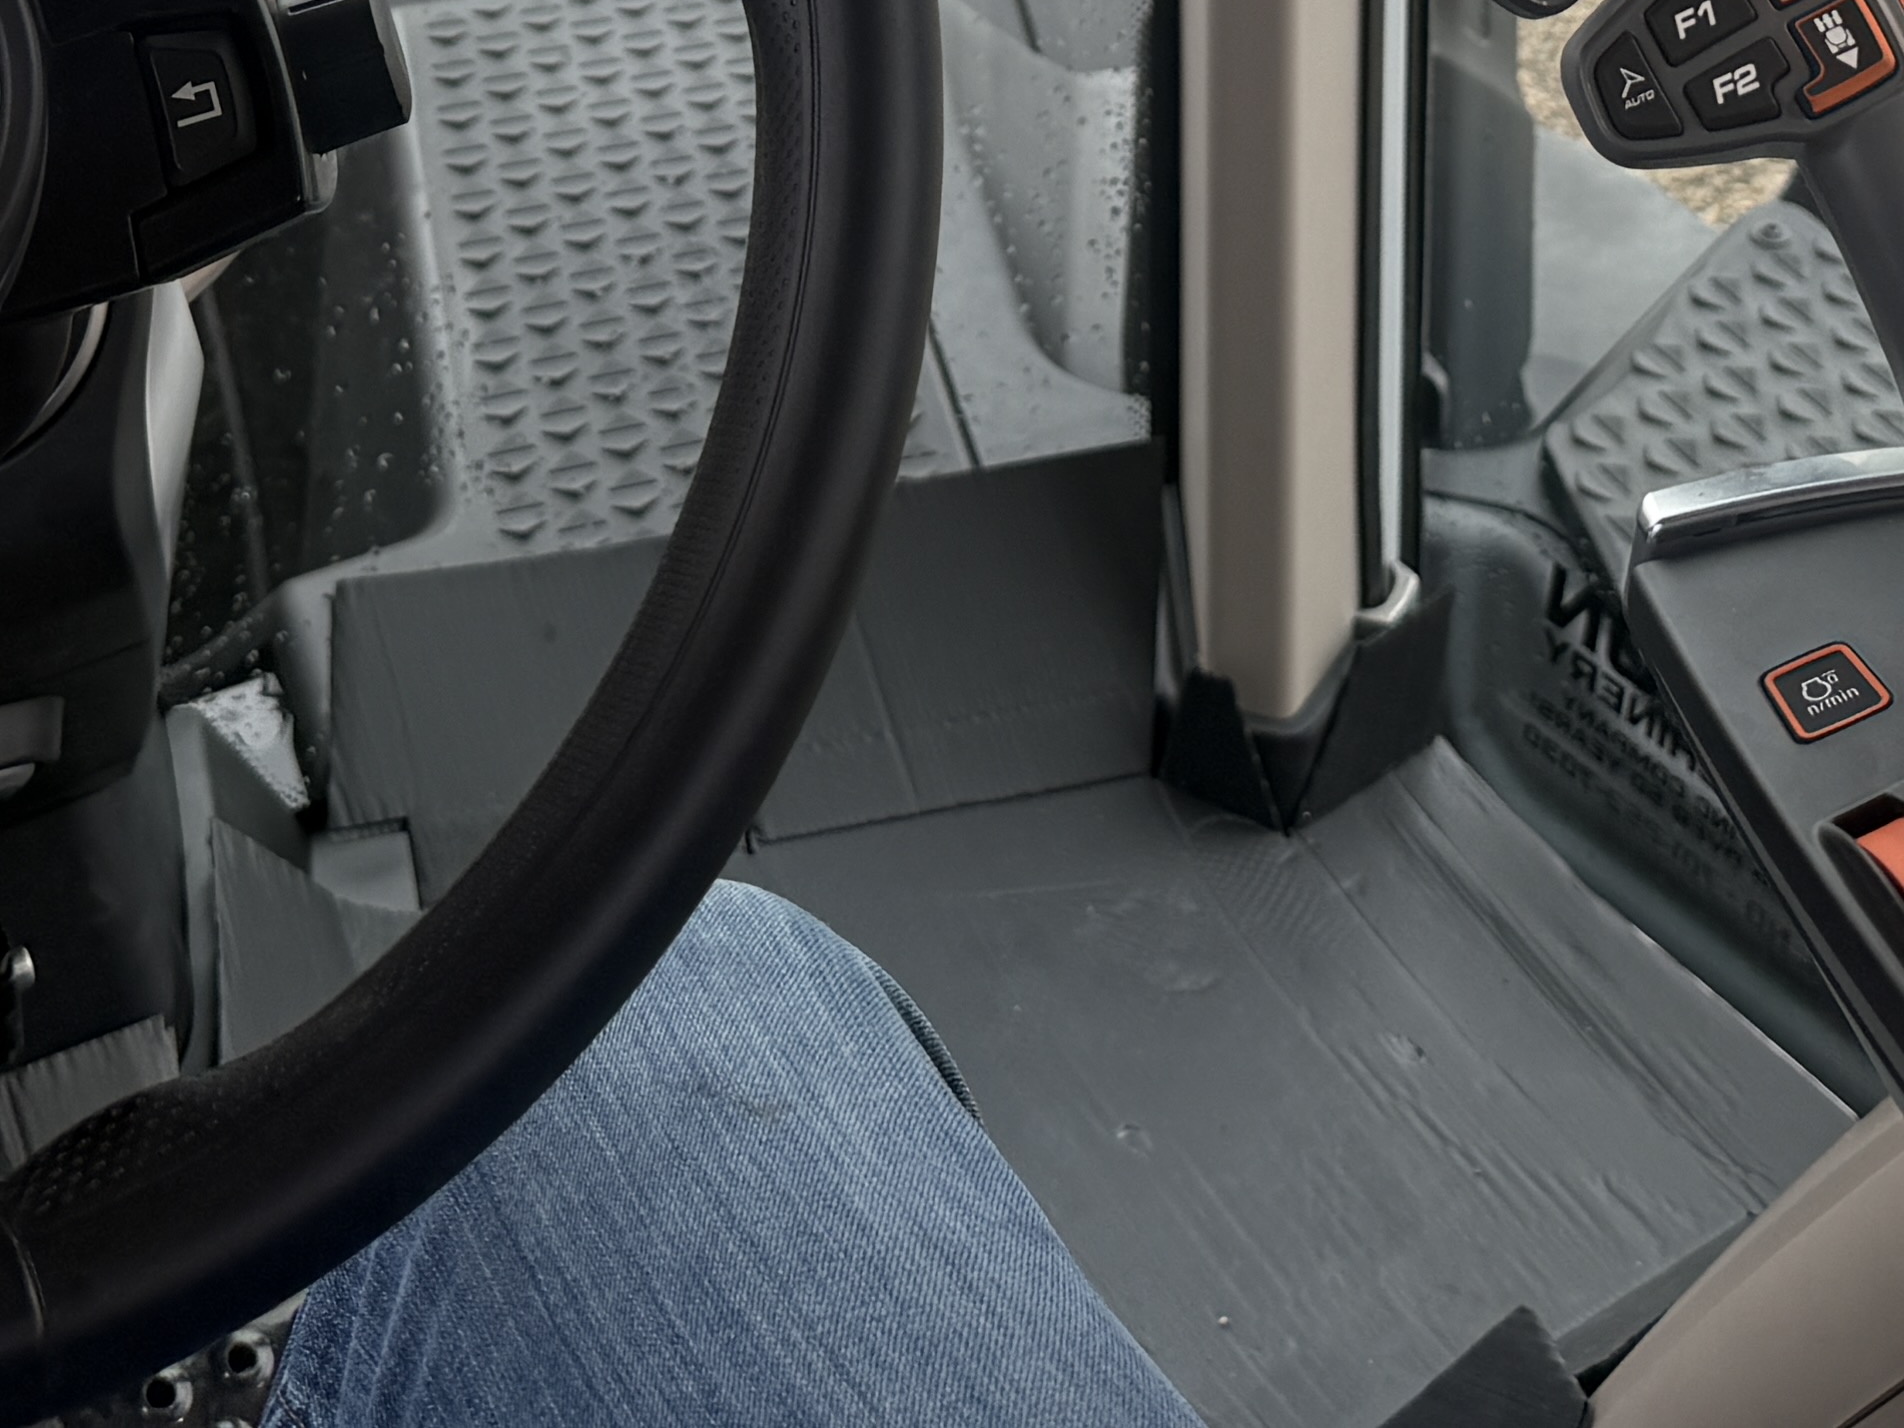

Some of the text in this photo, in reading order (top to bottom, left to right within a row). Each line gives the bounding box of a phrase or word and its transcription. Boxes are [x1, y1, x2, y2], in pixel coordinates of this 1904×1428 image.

[1674, 0, 1718, 40] F1
[1623, 88, 1656, 111] AUTO
[1711, 62, 1761, 105] F2
[1807, 687, 1860, 717] n/min
